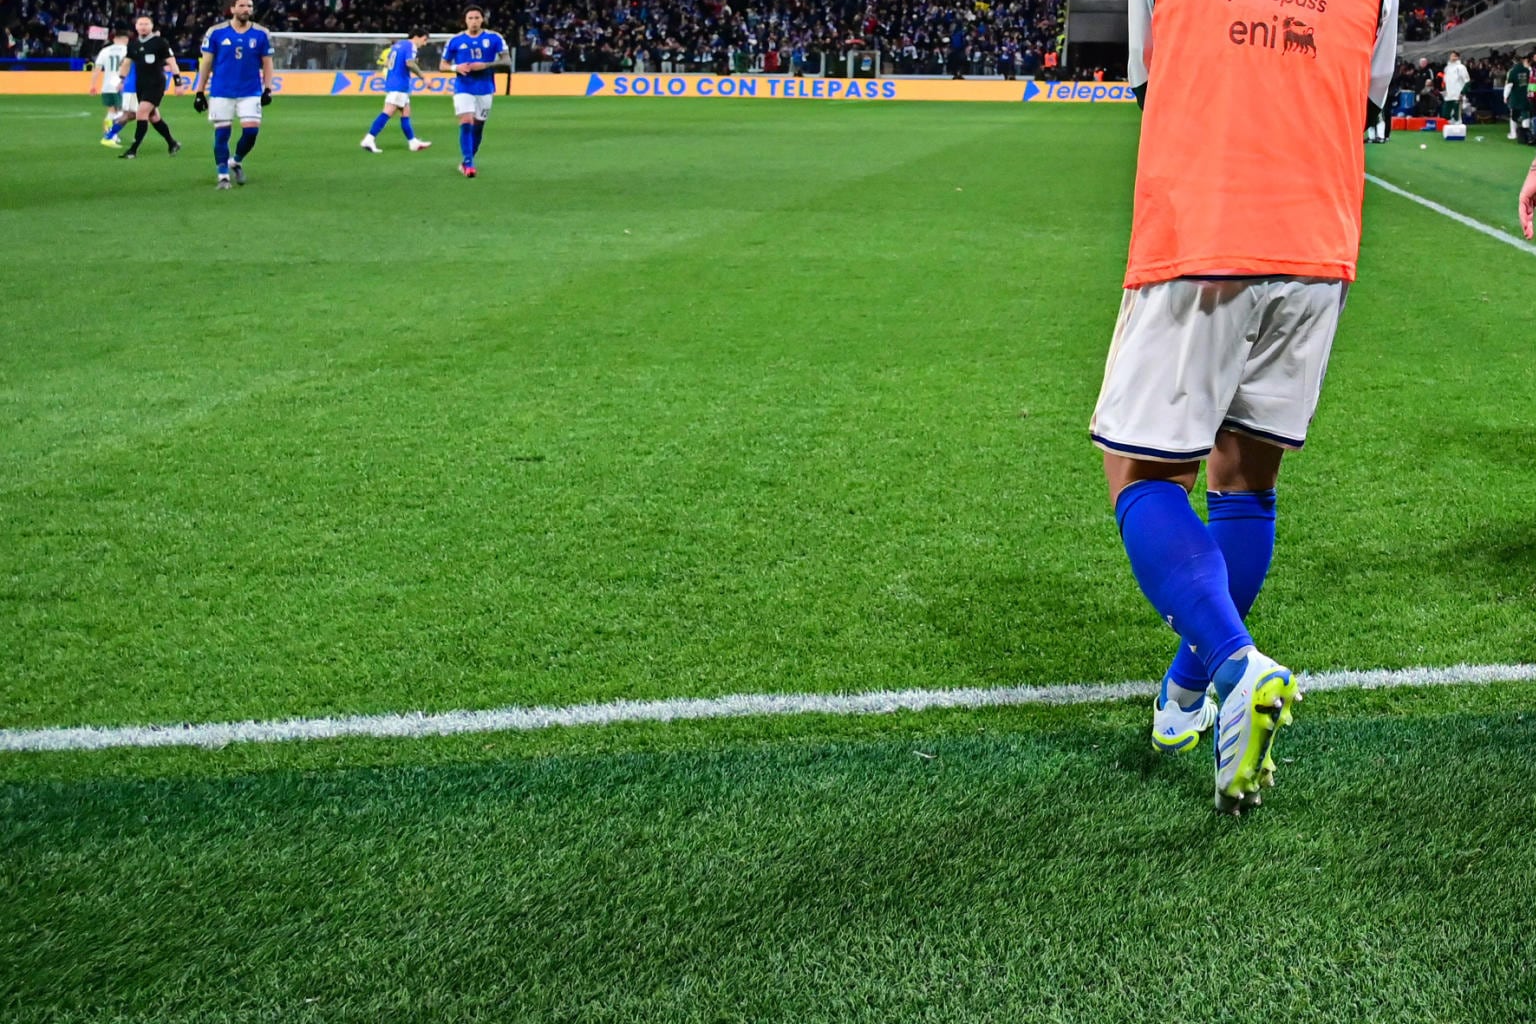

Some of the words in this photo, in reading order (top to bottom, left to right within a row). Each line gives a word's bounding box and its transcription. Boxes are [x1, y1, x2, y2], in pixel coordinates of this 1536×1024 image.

[1229, 15, 1279, 49] eni
[235, 47, 244, 59] 5
[470, 48, 483, 59] 13
[614, 77, 687, 95] SOLO
[696, 78, 757, 96] CON
[767, 79, 896, 98] TELEPASS
[1044, 80, 1137, 102] Telepas
